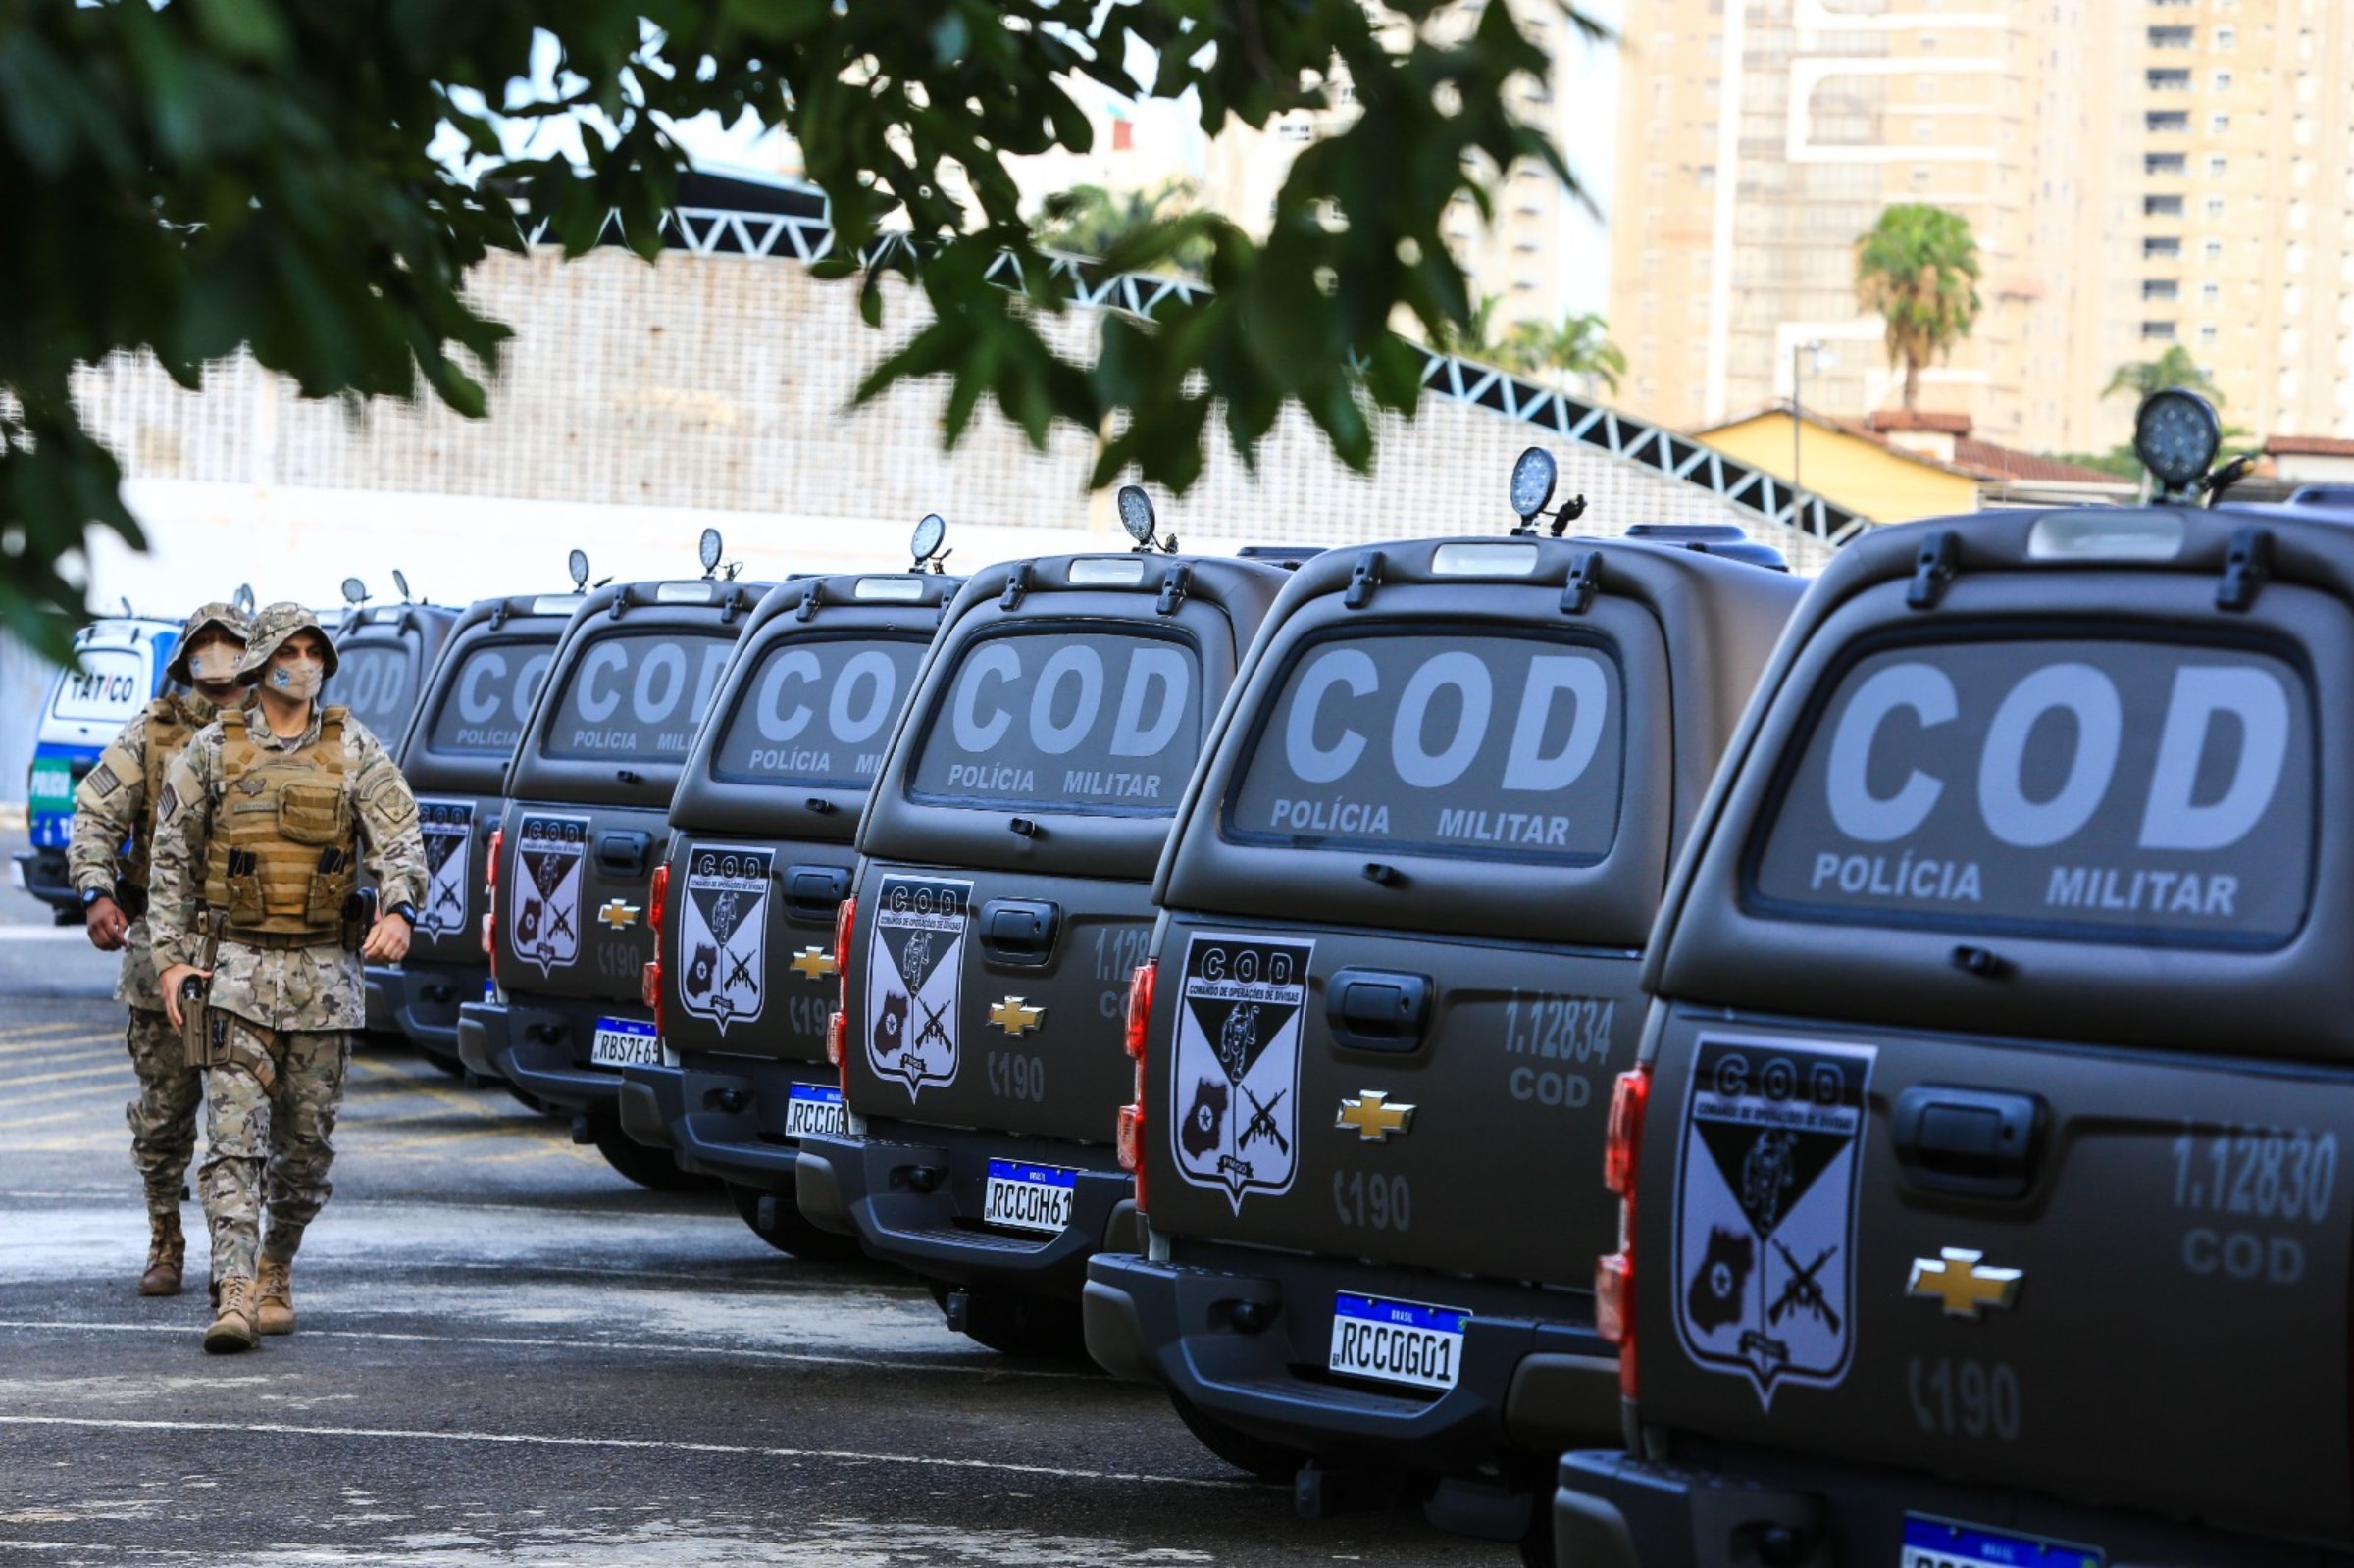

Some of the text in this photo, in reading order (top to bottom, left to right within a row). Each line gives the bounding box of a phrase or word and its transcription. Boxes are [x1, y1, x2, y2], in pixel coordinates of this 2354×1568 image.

[952, 643, 1190, 758] COD
[1285, 648, 1608, 791] COD
[573, 728, 637, 750] POLÍCIA
[748, 746, 831, 772] POLÍCIA
[1826, 662, 2290, 851] COD
[947, 761, 1162, 798] POLÍCIA MILITAR
[1270, 795, 1569, 847] POLÍCIA MILITAR
[698, 853, 761, 881] COD
[1812, 849, 2239, 918] POLÍCIA MILITAR
[890, 885, 957, 917] COD
[606, 942, 640, 979] 190
[1202, 947, 1294, 988] COD
[1190, 985, 1218, 996] COMANDO
[1219, 987, 1229, 997] DE
[1265, 990, 1274, 1000] DE
[1275, 990, 1300, 1003] DIVISAS
[1506, 986, 1615, 1067] 1.12834
[999, 1053, 1045, 1103] 190
[1510, 1067, 1591, 1108] COD
[1713, 1051, 1845, 1106] COD
[2171, 1118, 2340, 1224] 1.12830
[1349, 1170, 1410, 1232] 190
[2182, 1228, 2305, 1287] COD
[1931, 1357, 2021, 1439] 190
